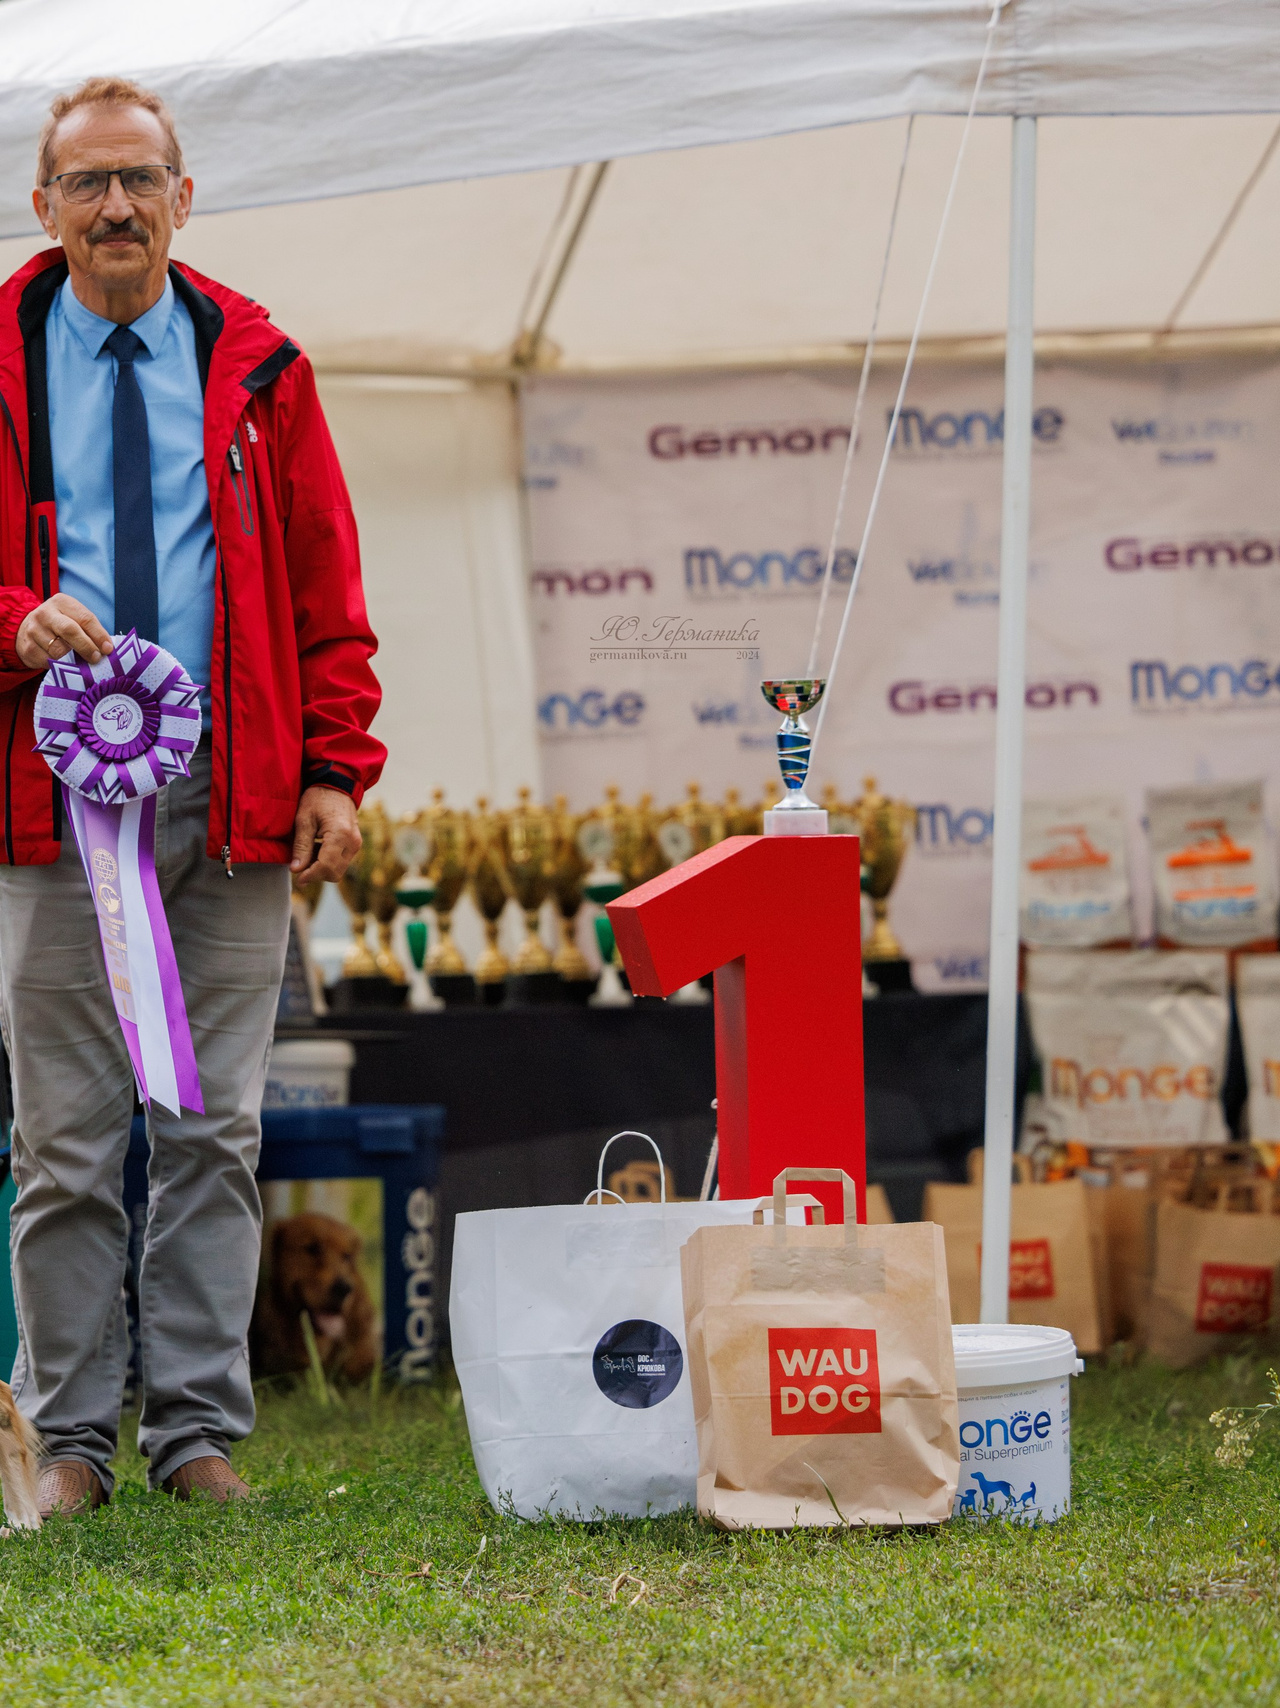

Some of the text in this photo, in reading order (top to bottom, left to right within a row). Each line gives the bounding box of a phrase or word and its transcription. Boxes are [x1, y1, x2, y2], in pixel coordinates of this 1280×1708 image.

[648, 424, 858, 461] Gemon
[1105, 537, 1280, 571] Gemo
[531, 568, 654, 597] mon
[776, 1348, 869, 1377] WAU
[780, 1383, 871, 1415] DOG
[974, 1439, 1053, 1461] Superpremium
